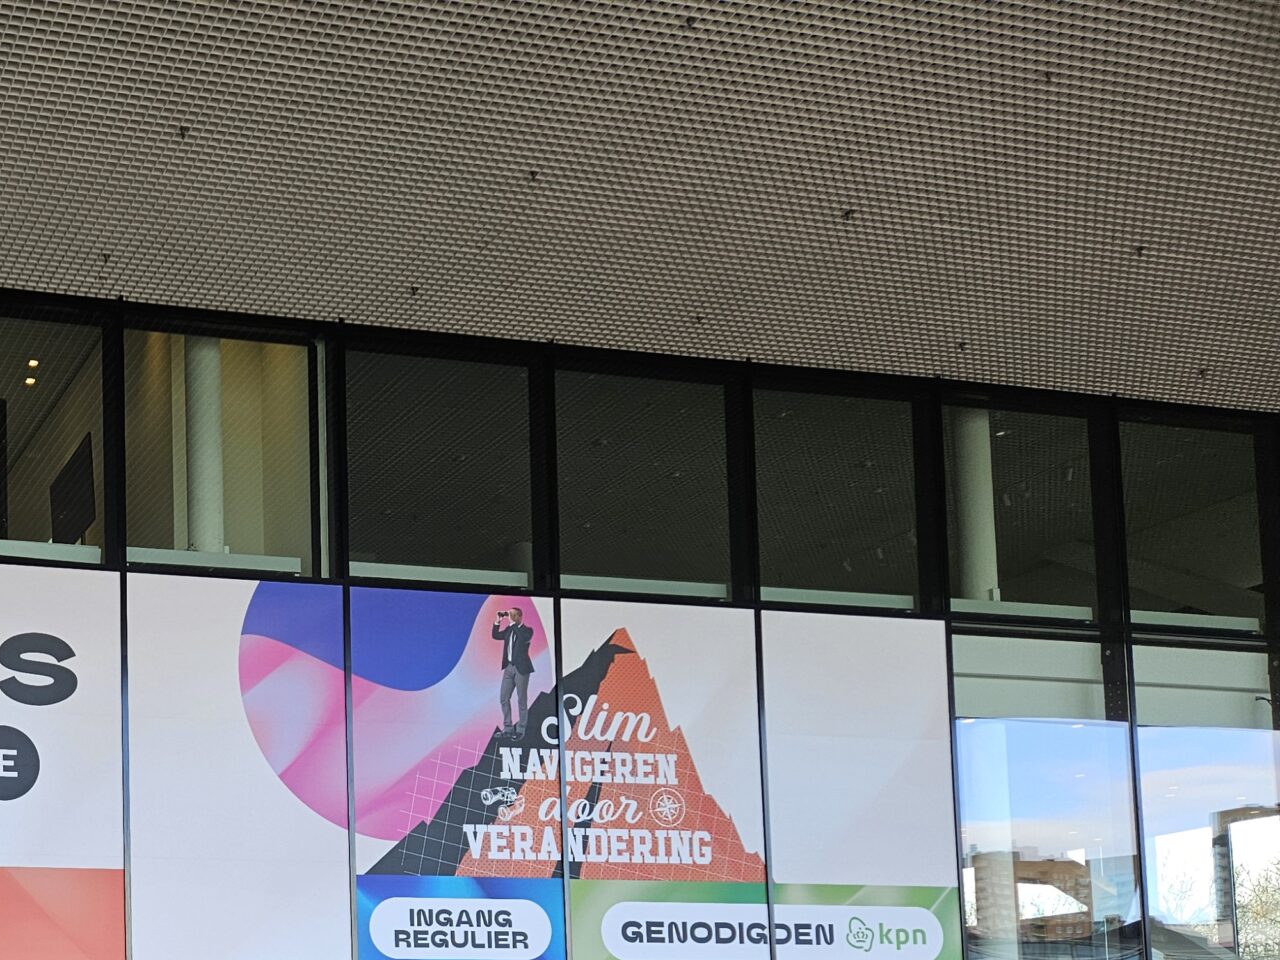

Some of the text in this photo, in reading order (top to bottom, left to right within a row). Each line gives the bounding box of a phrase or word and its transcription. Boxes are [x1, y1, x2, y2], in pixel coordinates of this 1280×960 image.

[540, 693, 658, 747] Slim
[499, 746, 679, 785] NAVIGEREN
[538, 785, 649, 824] door
[463, 823, 713, 866] VERANDERING
[408, 908, 513, 929] INGANG
[620, 919, 927, 951] GENODIGDEN kpn
[393, 928, 529, 950] REGULIER
